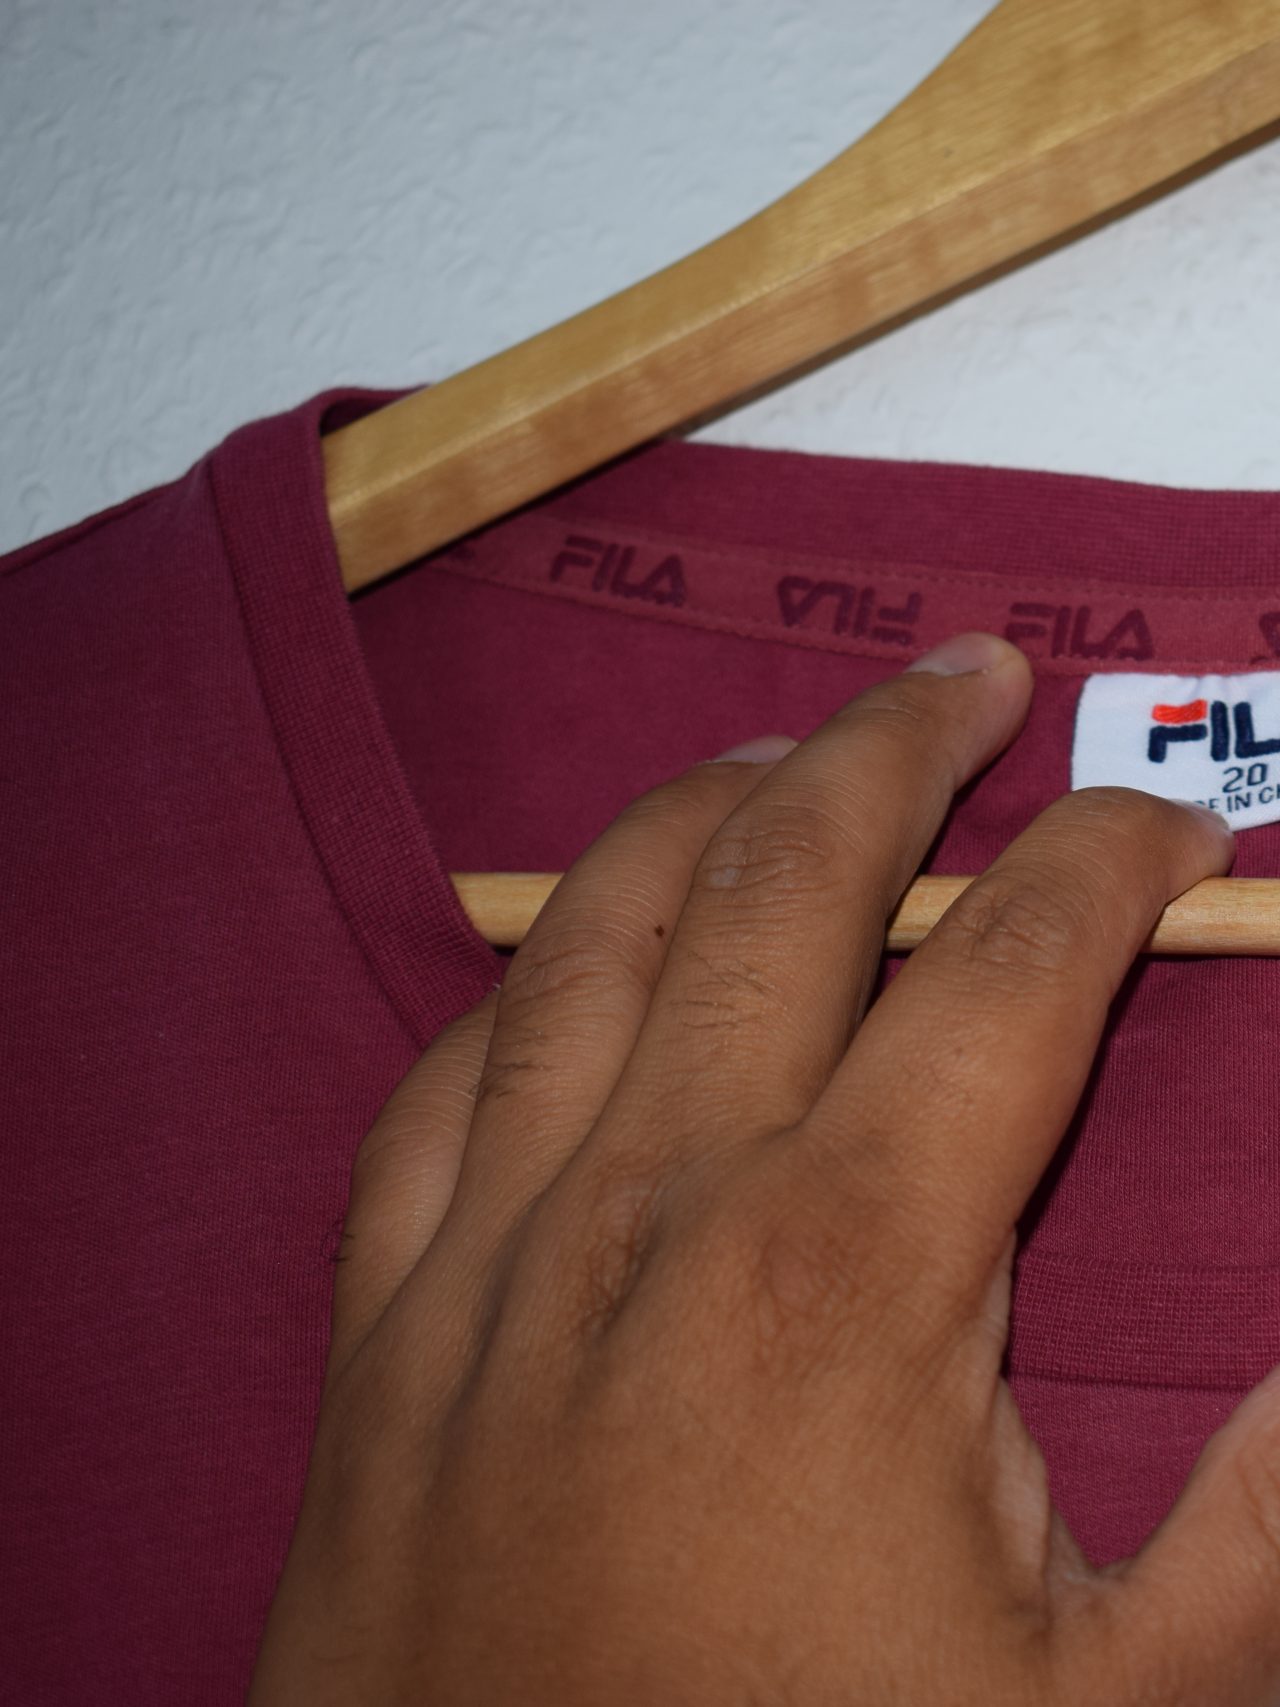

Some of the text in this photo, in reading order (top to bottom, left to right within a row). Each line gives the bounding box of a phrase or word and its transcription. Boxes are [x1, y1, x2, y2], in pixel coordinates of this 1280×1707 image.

[550, 534, 686, 607] FILA
[776, 575, 923, 645] FILA
[1005, 602, 1155, 661] FILA
[1222, 763, 1268, 793] 20
[1227, 792, 1251, 813] IN
